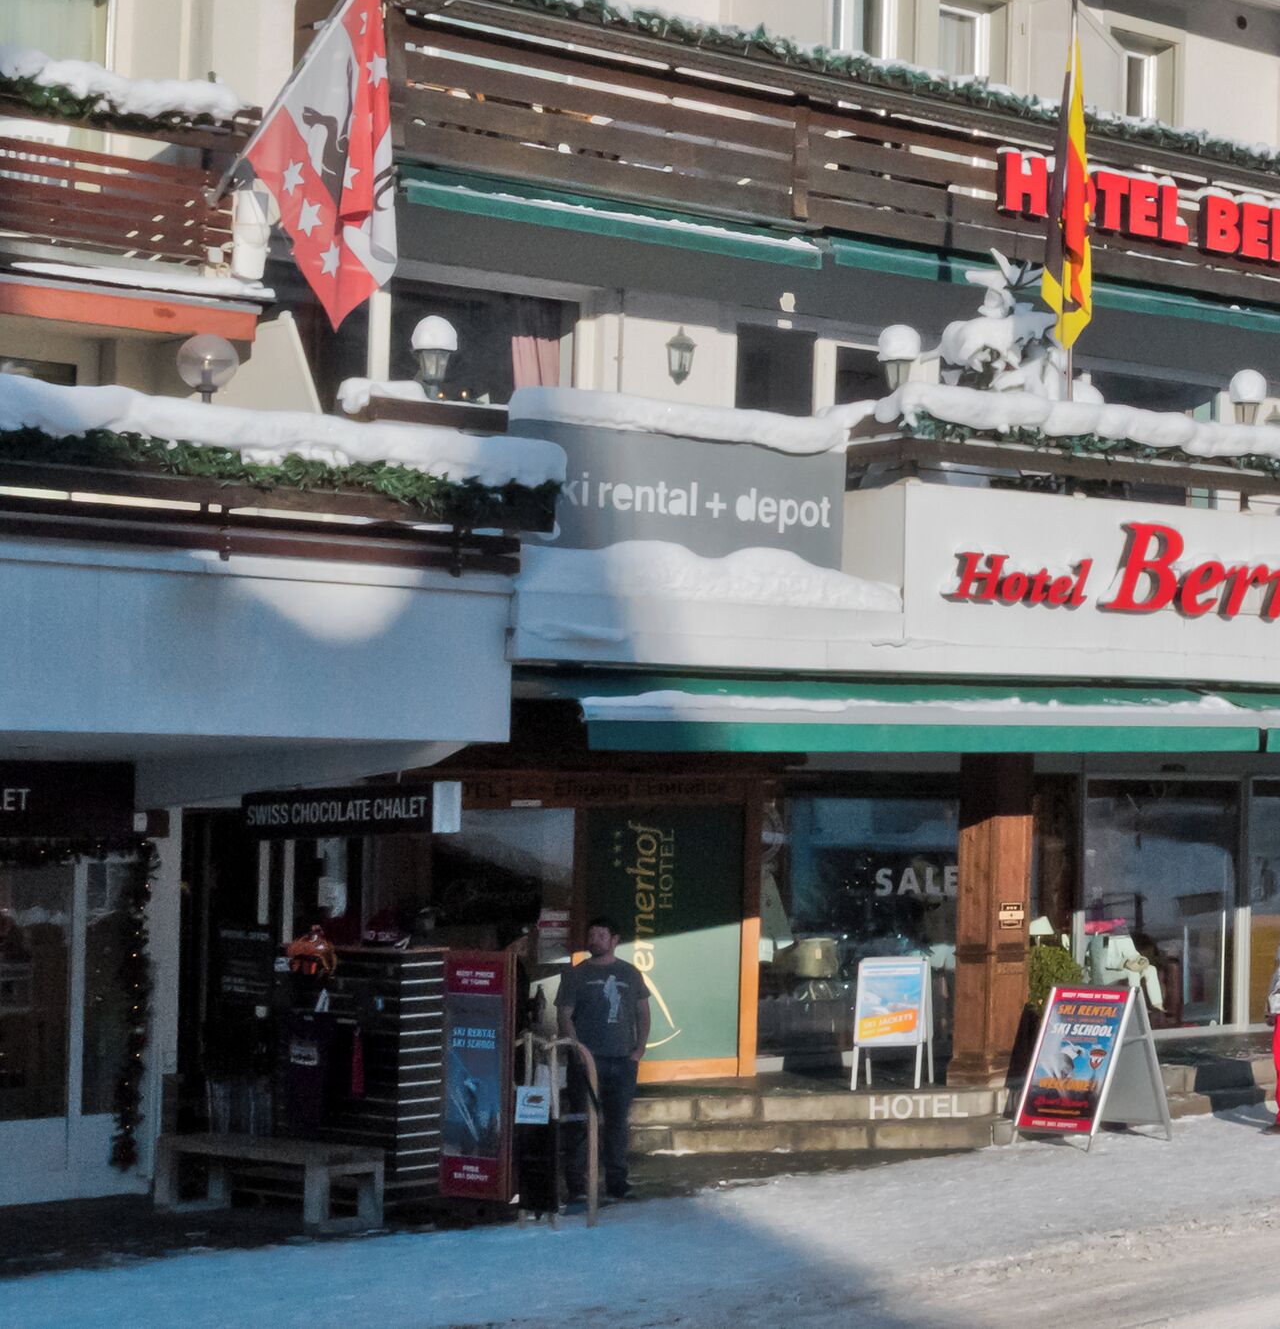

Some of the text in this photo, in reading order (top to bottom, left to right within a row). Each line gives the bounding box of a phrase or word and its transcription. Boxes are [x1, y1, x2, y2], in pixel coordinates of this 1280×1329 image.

[1005, 152, 1189, 244] HTEL
[561, 472, 588, 507] ki
[599, 481, 697, 516] rental
[735, 488, 830, 533] depot
[956, 552, 1092, 606] Hotel
[0, 788, 31, 811] ET
[247, 796, 427, 826] SWISS CHOCOLATE CHALET
[659, 829, 674, 909] HOTEL
[874, 866, 959, 898] SALE
[625, 820, 663, 973] ernerhof
[1057, 1004, 1118, 1018] SKI RENTAL
[453, 1026, 497, 1038] SKI RENTAL
[453, 1039, 496, 1050] SKI SCHOOL
[1051, 1022, 1114, 1037] SKI SCHOOL
[869, 1095, 969, 1120] HOTEL
